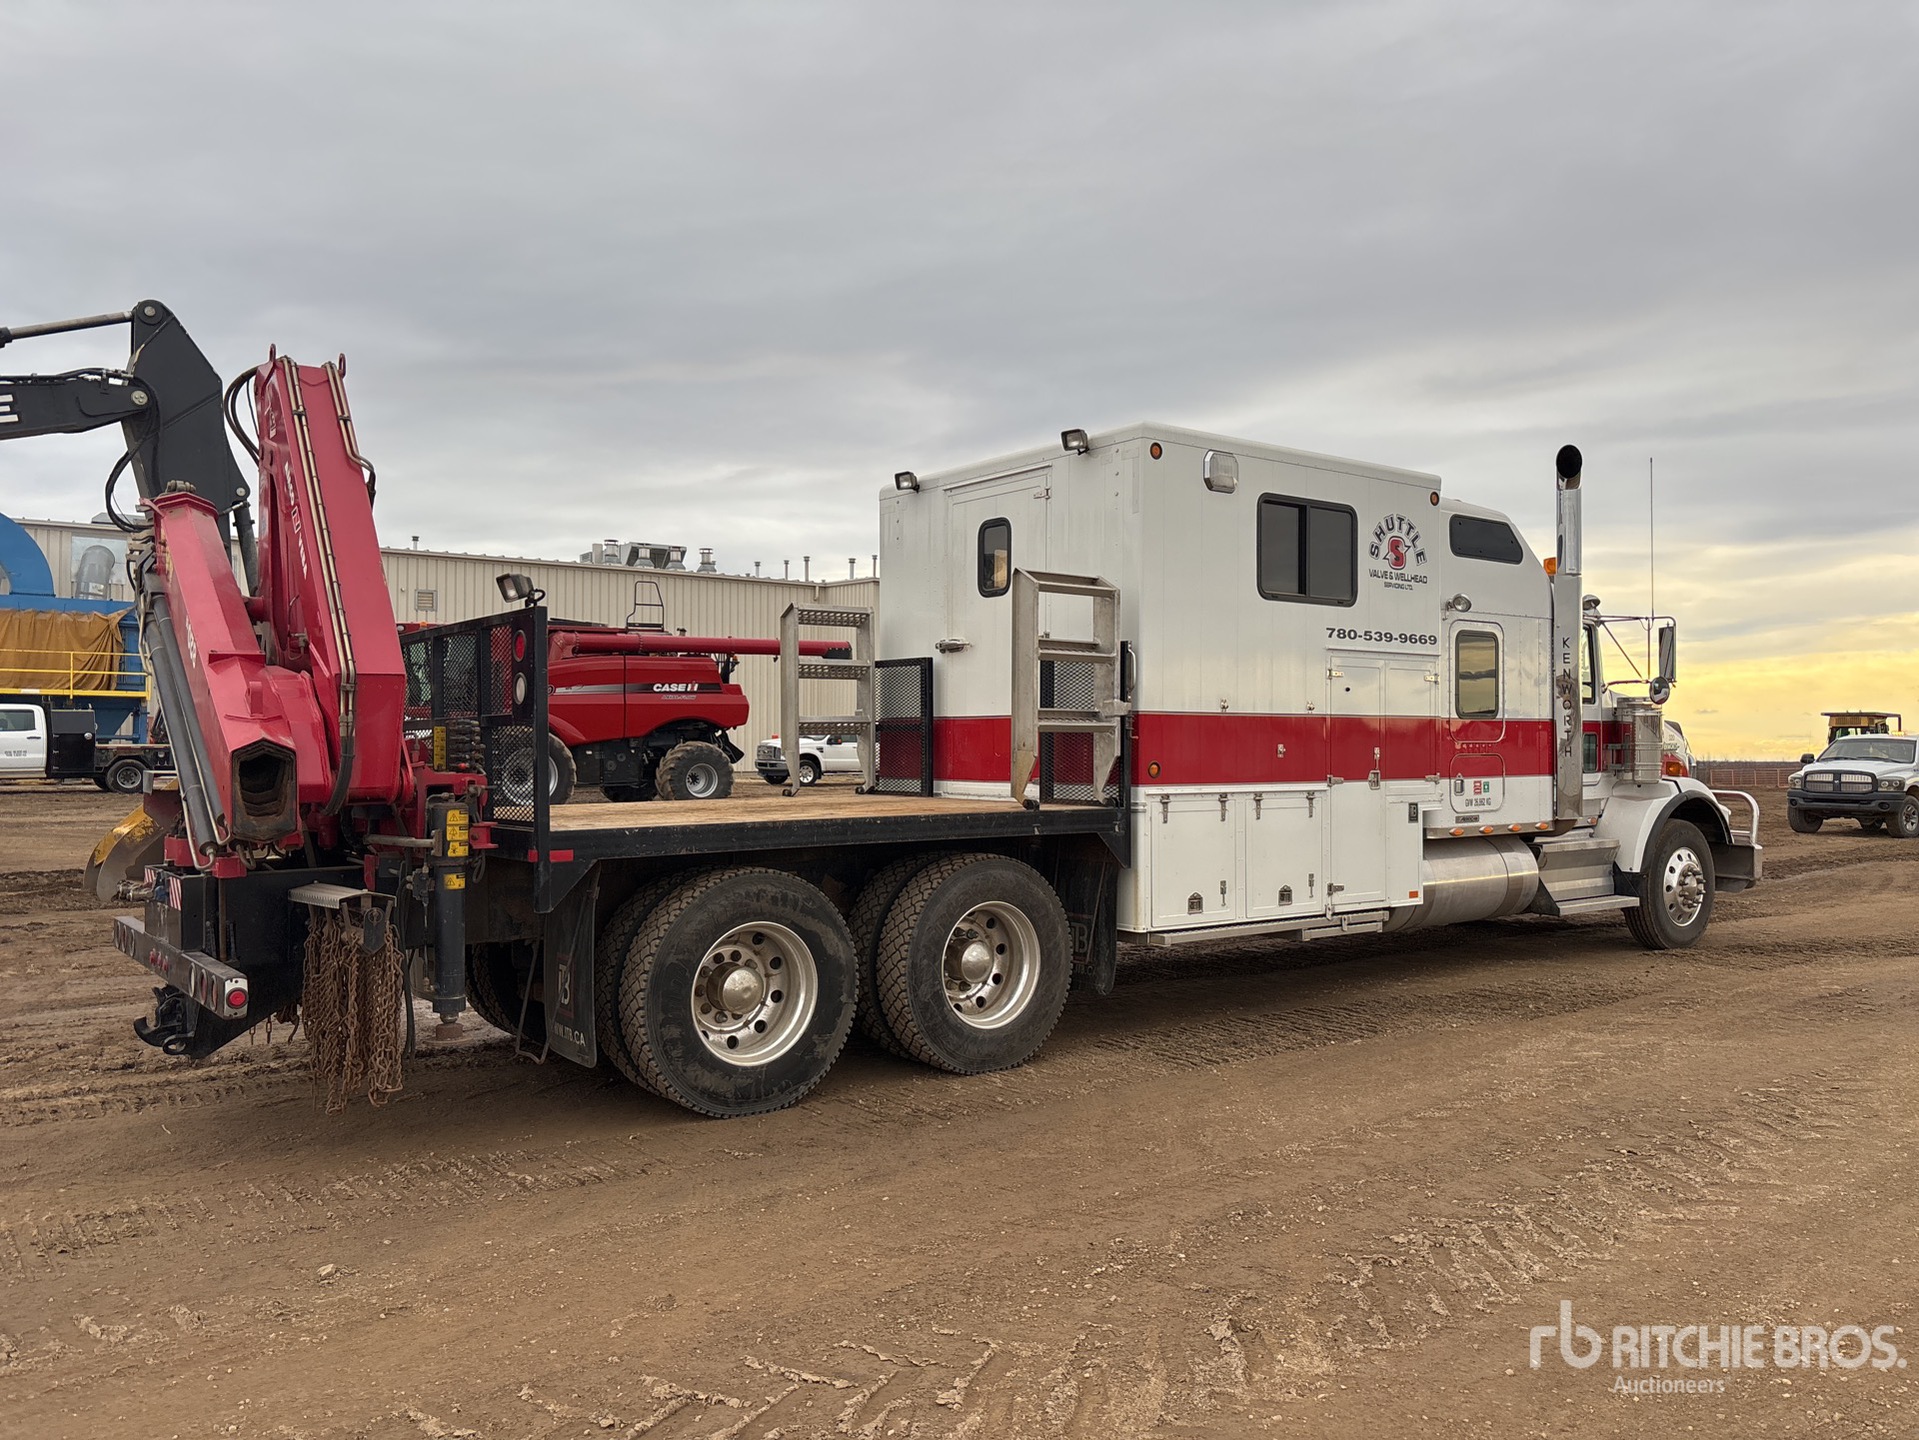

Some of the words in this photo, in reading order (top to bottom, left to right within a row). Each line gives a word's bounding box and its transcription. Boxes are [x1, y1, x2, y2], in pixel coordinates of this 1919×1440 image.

[1369, 514, 1427, 566] SHUTTLE
[1369, 569, 1388, 581] VALVE
[1394, 572, 1428, 584] WELLHEAD
[1326, 627, 1438, 646] 780-539-9669
[653, 683, 687, 692] CASE
[1562, 637, 1573, 758] KENWORTH
